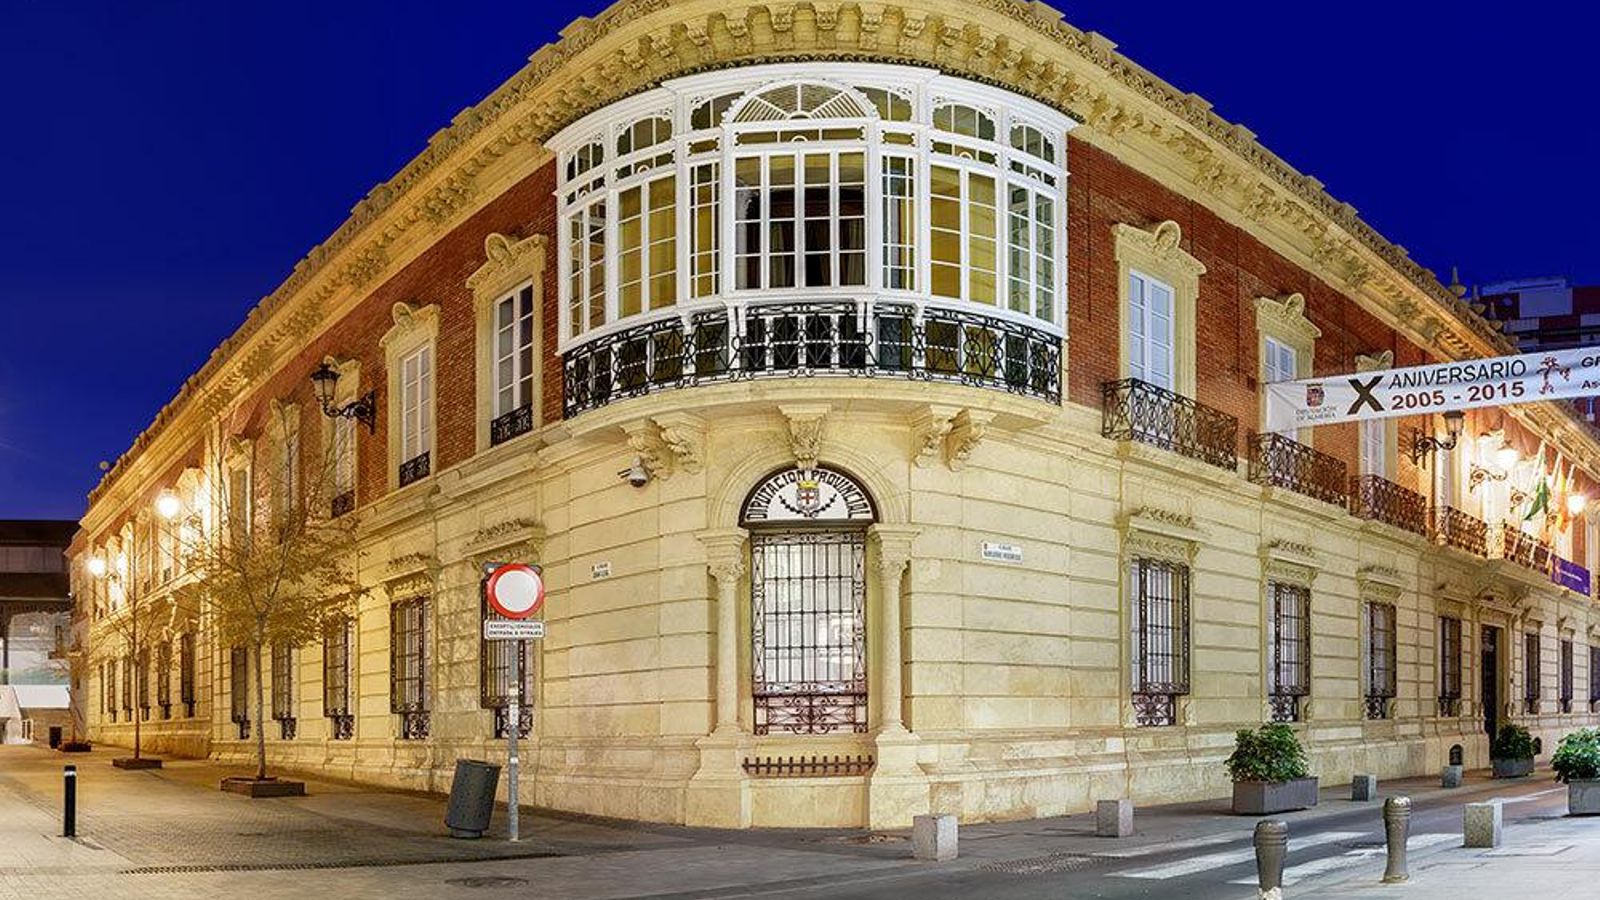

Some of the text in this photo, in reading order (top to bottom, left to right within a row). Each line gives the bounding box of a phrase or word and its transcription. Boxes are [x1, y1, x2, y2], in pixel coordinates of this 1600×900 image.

[1388, 359, 1527, 390] ANIVERSARIO
[1347, 375, 1385, 415] X
[1391, 390, 1446, 410] 2005
[1467, 381, 1525, 402] 2015
[746, 469, 871, 521] DIPUTACION PROVINCIAL
